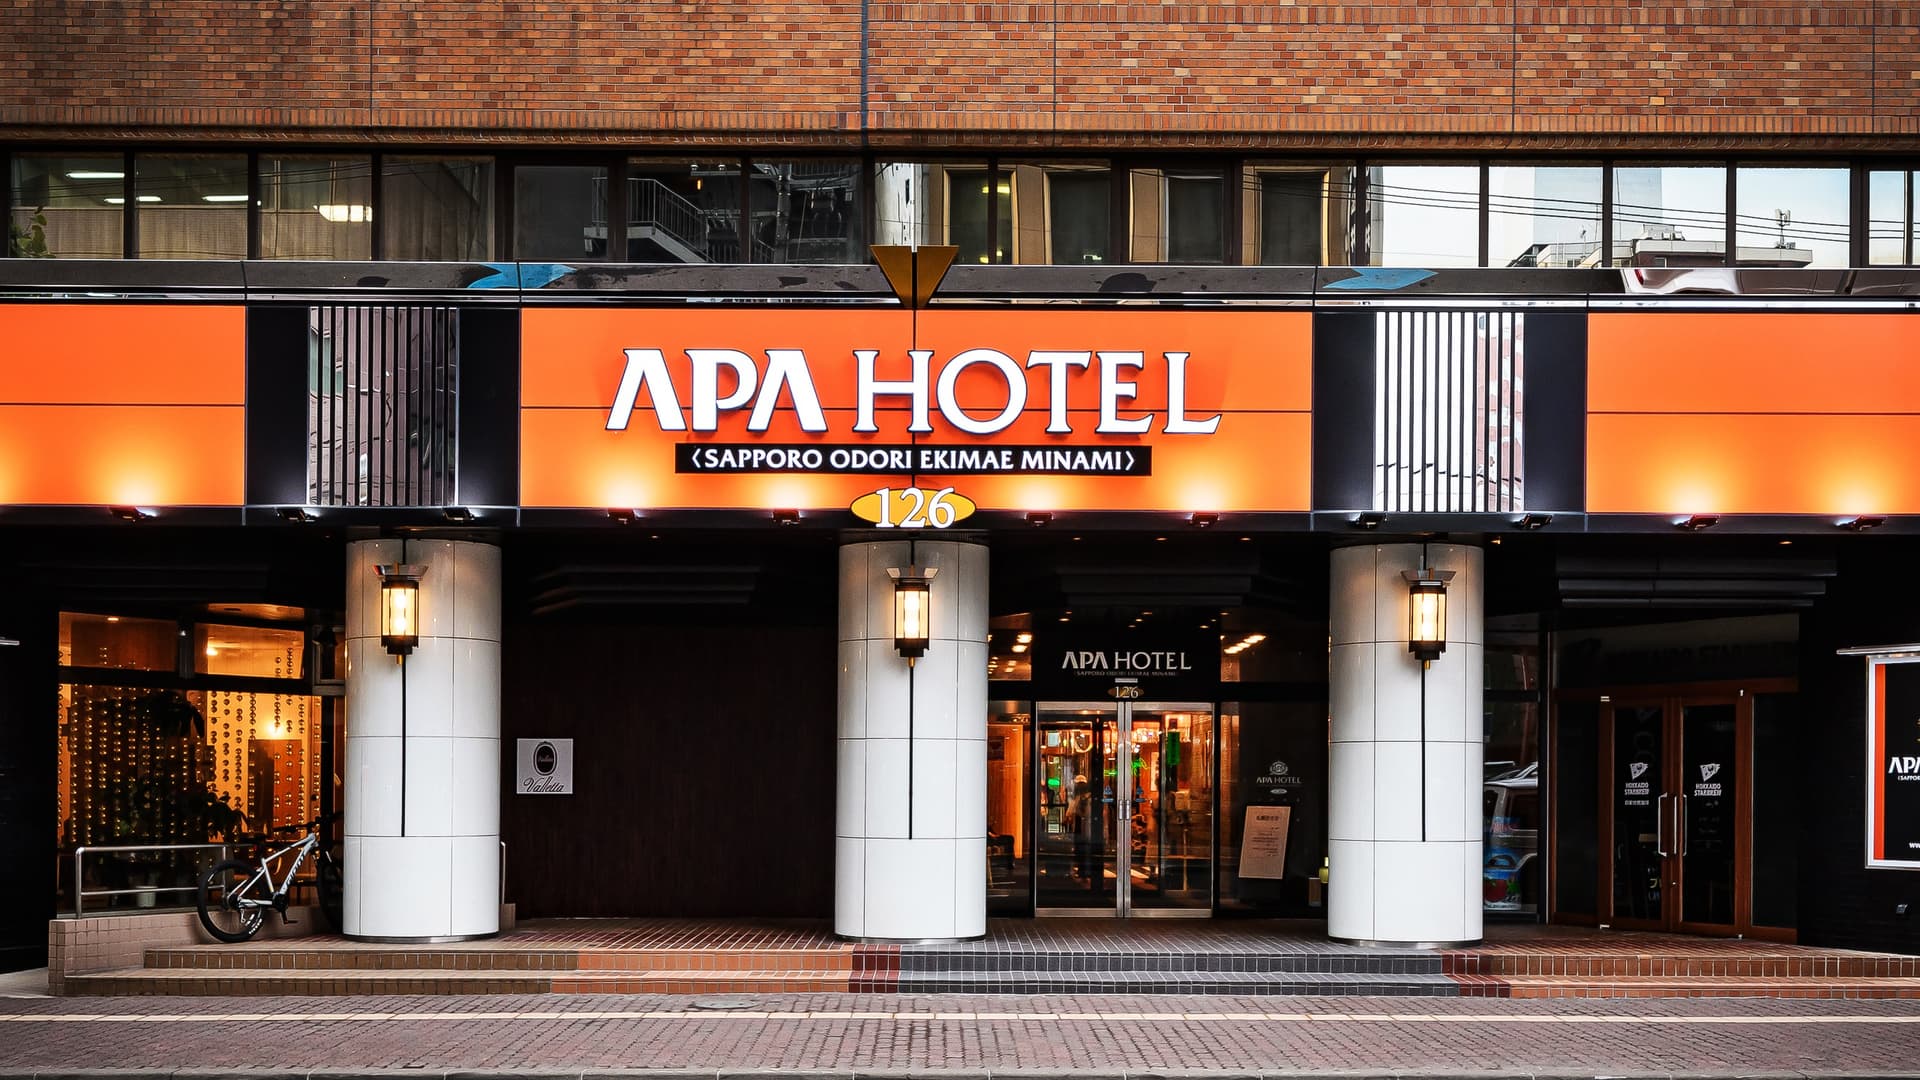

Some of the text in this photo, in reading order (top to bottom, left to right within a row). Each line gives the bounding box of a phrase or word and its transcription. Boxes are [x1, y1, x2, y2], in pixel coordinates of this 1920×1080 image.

[605, 348, 1222, 434] APA HOTEL
[830, 449, 912, 469] ODORI
[920, 450, 1014, 470] EKIMAE
[875, 487, 956, 528] 126
[1062, 651, 1192, 670] APA HOTEL
[1115, 686, 1139, 699] 126
